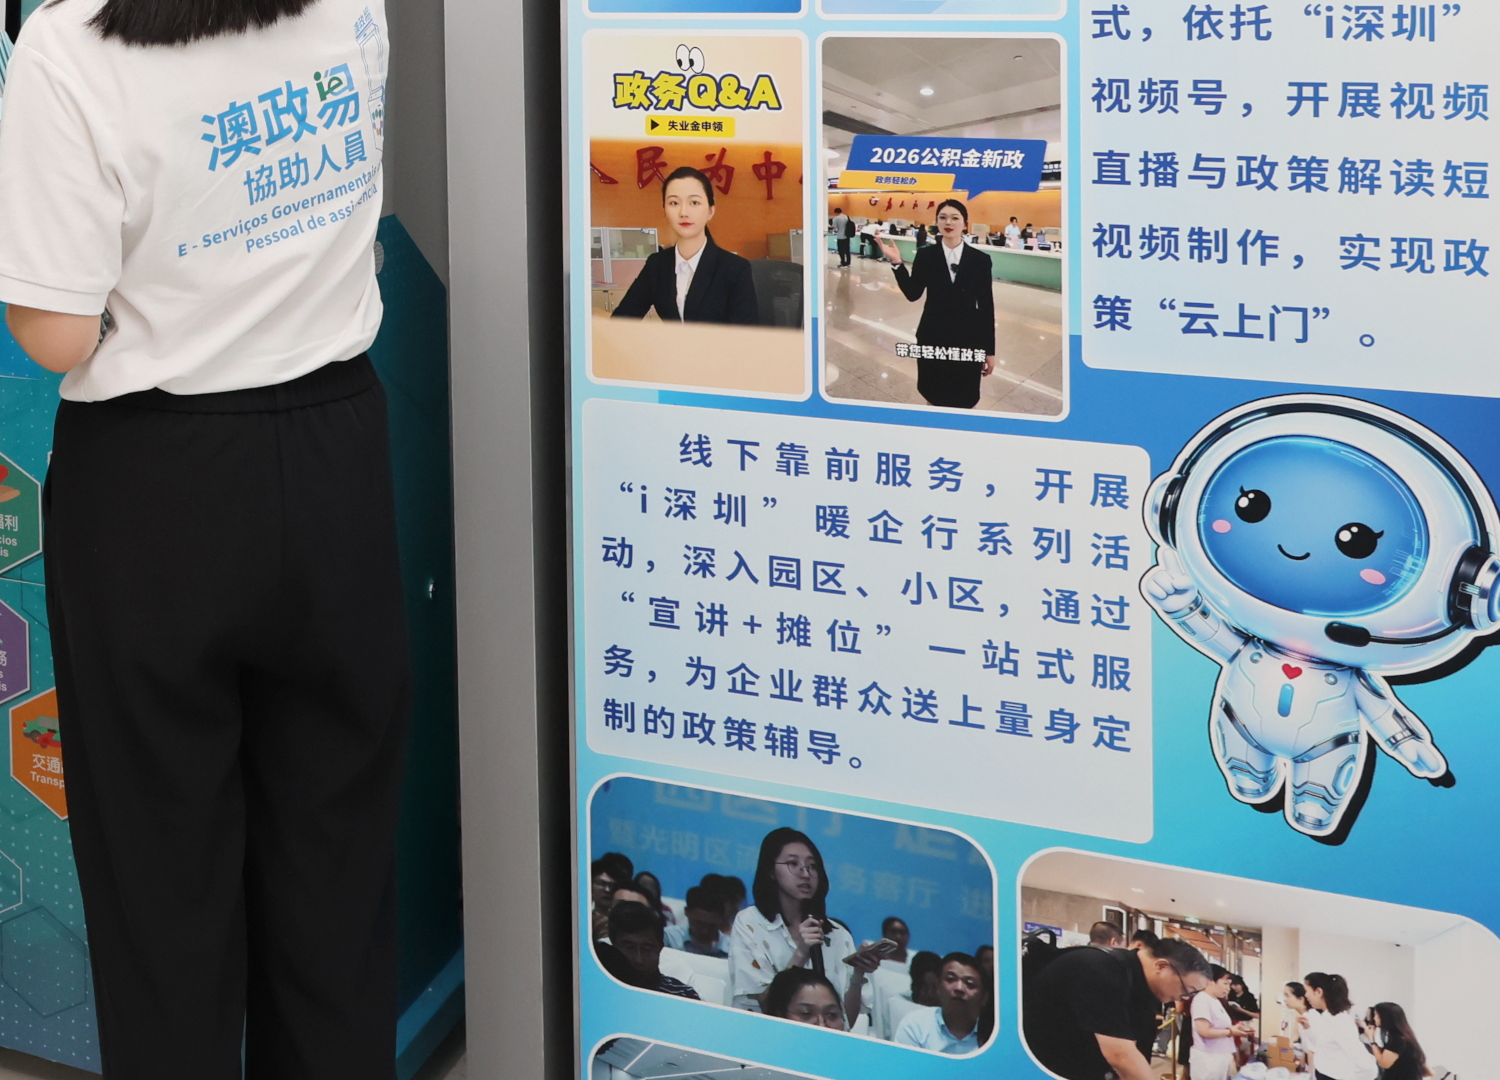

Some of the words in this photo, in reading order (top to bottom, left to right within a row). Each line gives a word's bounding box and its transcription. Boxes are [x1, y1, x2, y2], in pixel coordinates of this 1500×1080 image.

[613, 70, 782, 112] 政务Q&A
[1091, 78, 1490, 122] 视频号，开展视频
[668, 120, 724, 132] 失业金申领
[243, 130, 367, 206] 協助人員
[870, 147, 1025, 169] 2026公积金新政
[874, 176, 918, 186] 政务轻松办
[1091, 149, 1490, 199] 直播与政策解读短
[177, 244, 188, 257] E
[202, 213, 268, 249] Serviços
[271, 165, 377, 220] Governamentais
[245, 219, 305, 253] Pessoal
[307, 210, 326, 231] de
[1091, 222, 1490, 277] 视频制作，实现政
[896, 343, 987, 363] 带您轻松懂政策
[679, 433, 1131, 510] 线下靠前服务，开展
[601, 536, 1132, 632] 动，深入园区、小区，通过
[602, 644, 1132, 754] 务，为企业群众送上量身定
[602, 698, 863, 772] 制的政策辅导。
[32, 754, 63, 775] 交通
